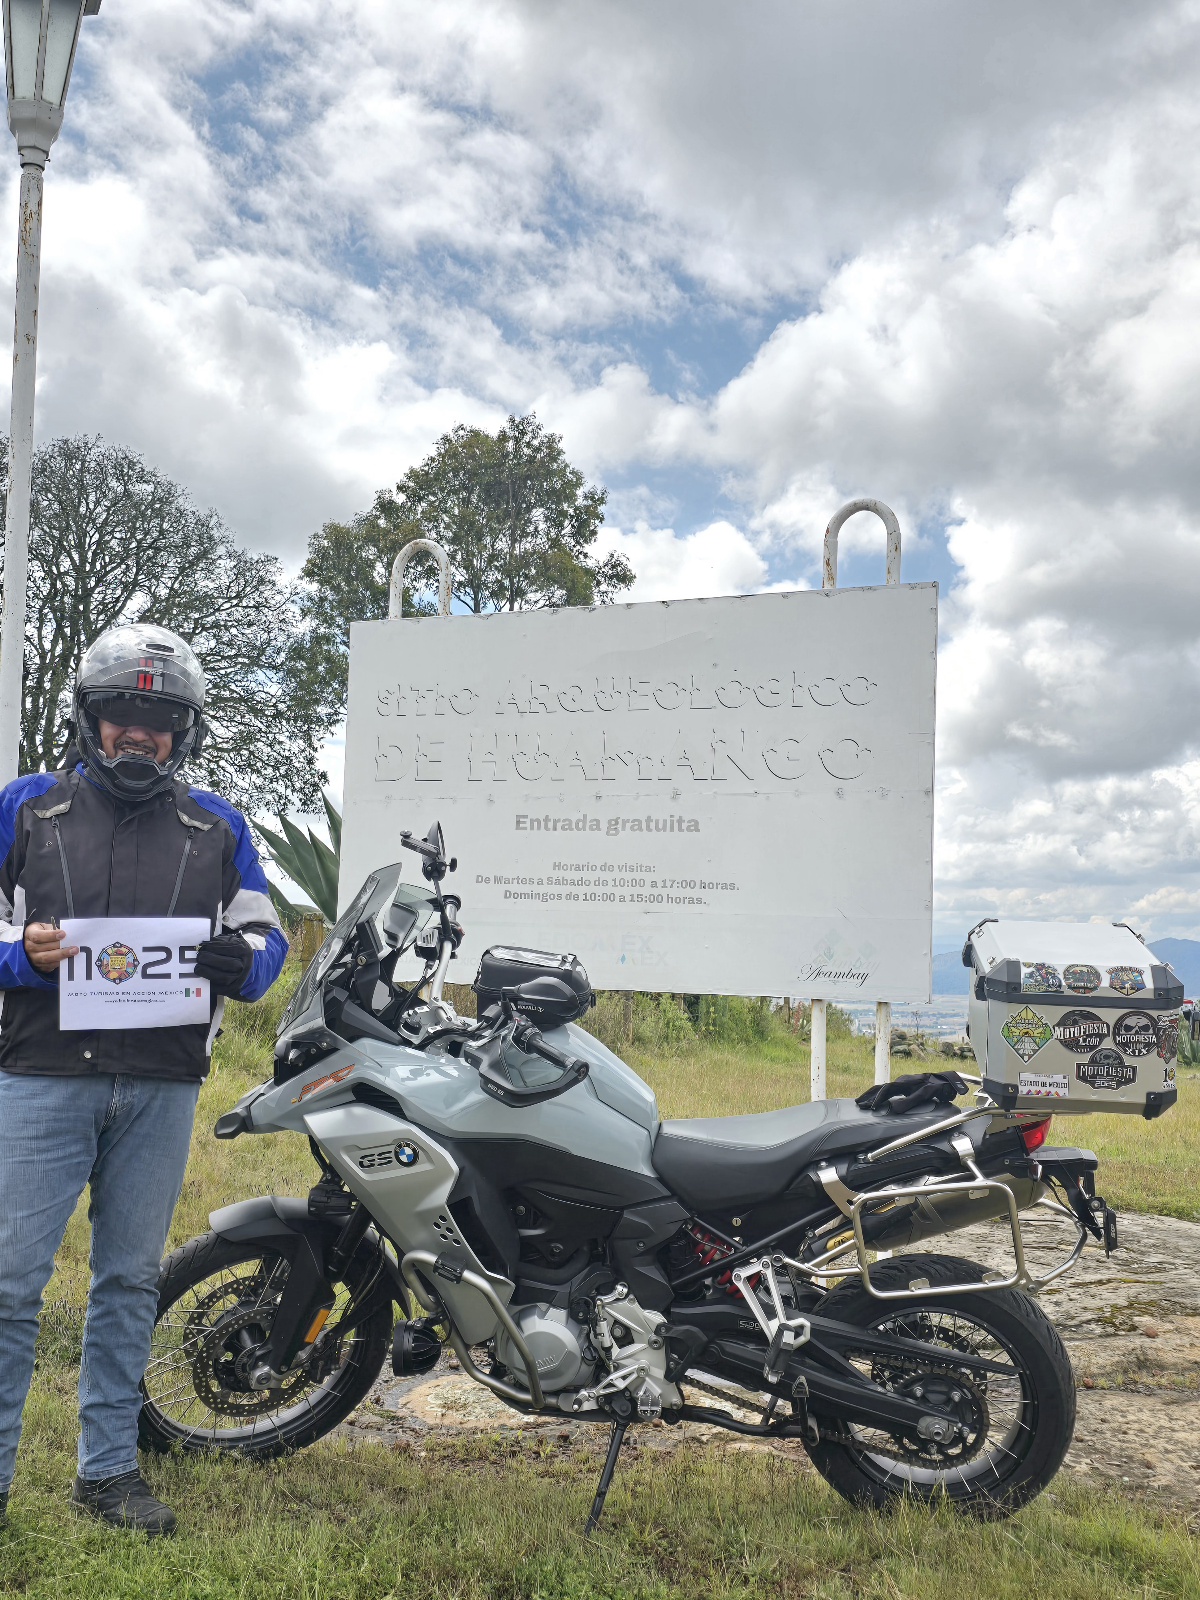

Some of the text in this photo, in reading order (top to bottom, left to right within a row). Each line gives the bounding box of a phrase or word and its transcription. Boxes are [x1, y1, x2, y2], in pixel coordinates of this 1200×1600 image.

[376, 669, 877, 717] SITIO ARQUEOLÓGICO
[374, 729, 875, 781] DE HUAMANGO
[515, 814, 700, 836] Entrada gratuita
[552, 861, 656, 873] Horario de visita:
[475, 874, 740, 891] De Martes a Sábado de 10:00 a 17:00 horas.
[503, 889, 707, 905] Domingos de 10:00 a 15:00 horas.
[797, 963, 871, 988] Acambay
[1115, 1034, 1157, 1044] MOTOFIESTA
[1125, 1047, 1149, 1056] XIX
[1080, 1065, 1132, 1079] MOTOFIESTA
[1020, 1079, 1040, 1087] ESTADO
[359, 1150, 393, 1169] GS
